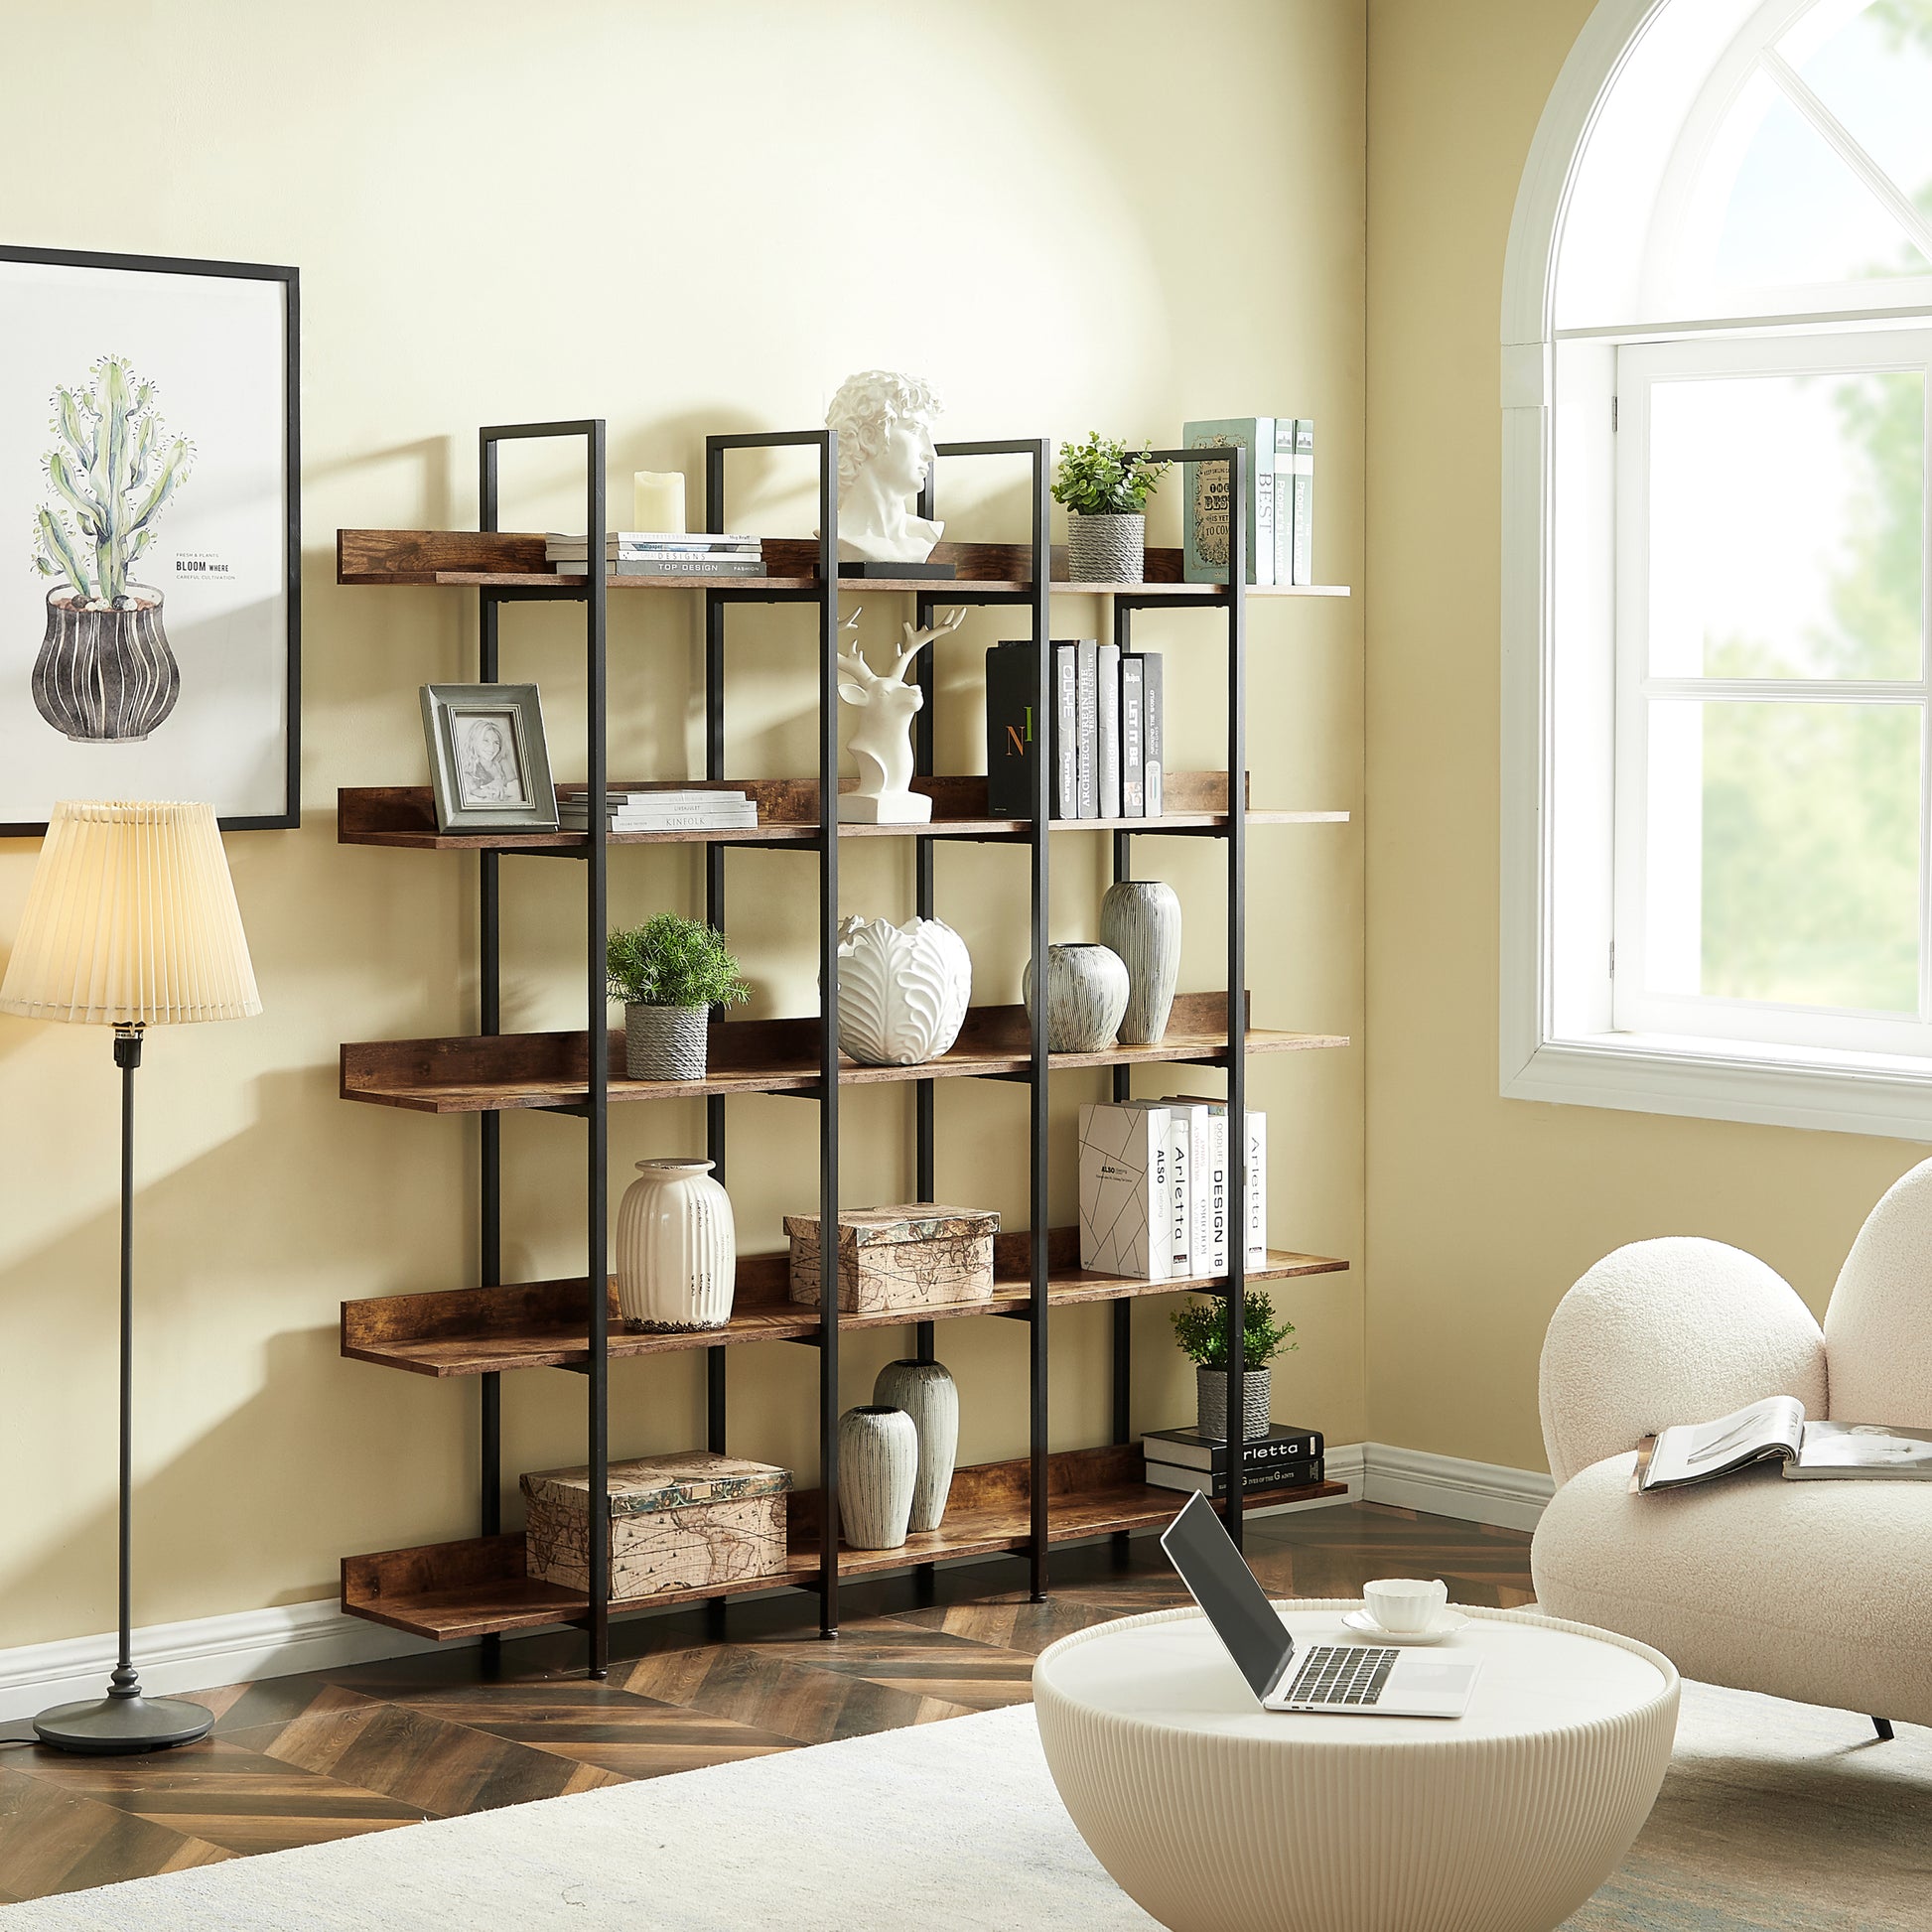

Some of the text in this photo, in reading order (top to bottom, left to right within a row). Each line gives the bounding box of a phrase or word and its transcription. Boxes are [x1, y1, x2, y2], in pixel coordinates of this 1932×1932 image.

[1204, 495, 1230, 510] BES
[1258, 474, 1272, 534] BEST
[1205, 527, 1215, 536] TO
[657, 552, 706, 561] DESIGNS
[176, 561, 207, 572] BLOOM
[681, 563, 719, 572] DESIGN
[1081, 697, 1089, 710] IN
[1108, 683, 1117, 782] Audrey Hepburn
[1129, 699, 1138, 766] LET IT BE
[666, 817, 707, 826] KINFOLK
[1174, 1147, 1185, 1240] Arletta
[1213, 1170, 1223, 1243] DESIGN
[1213, 1252, 1223, 1267] 18
[1243, 1444, 1298, 1460] rletta
